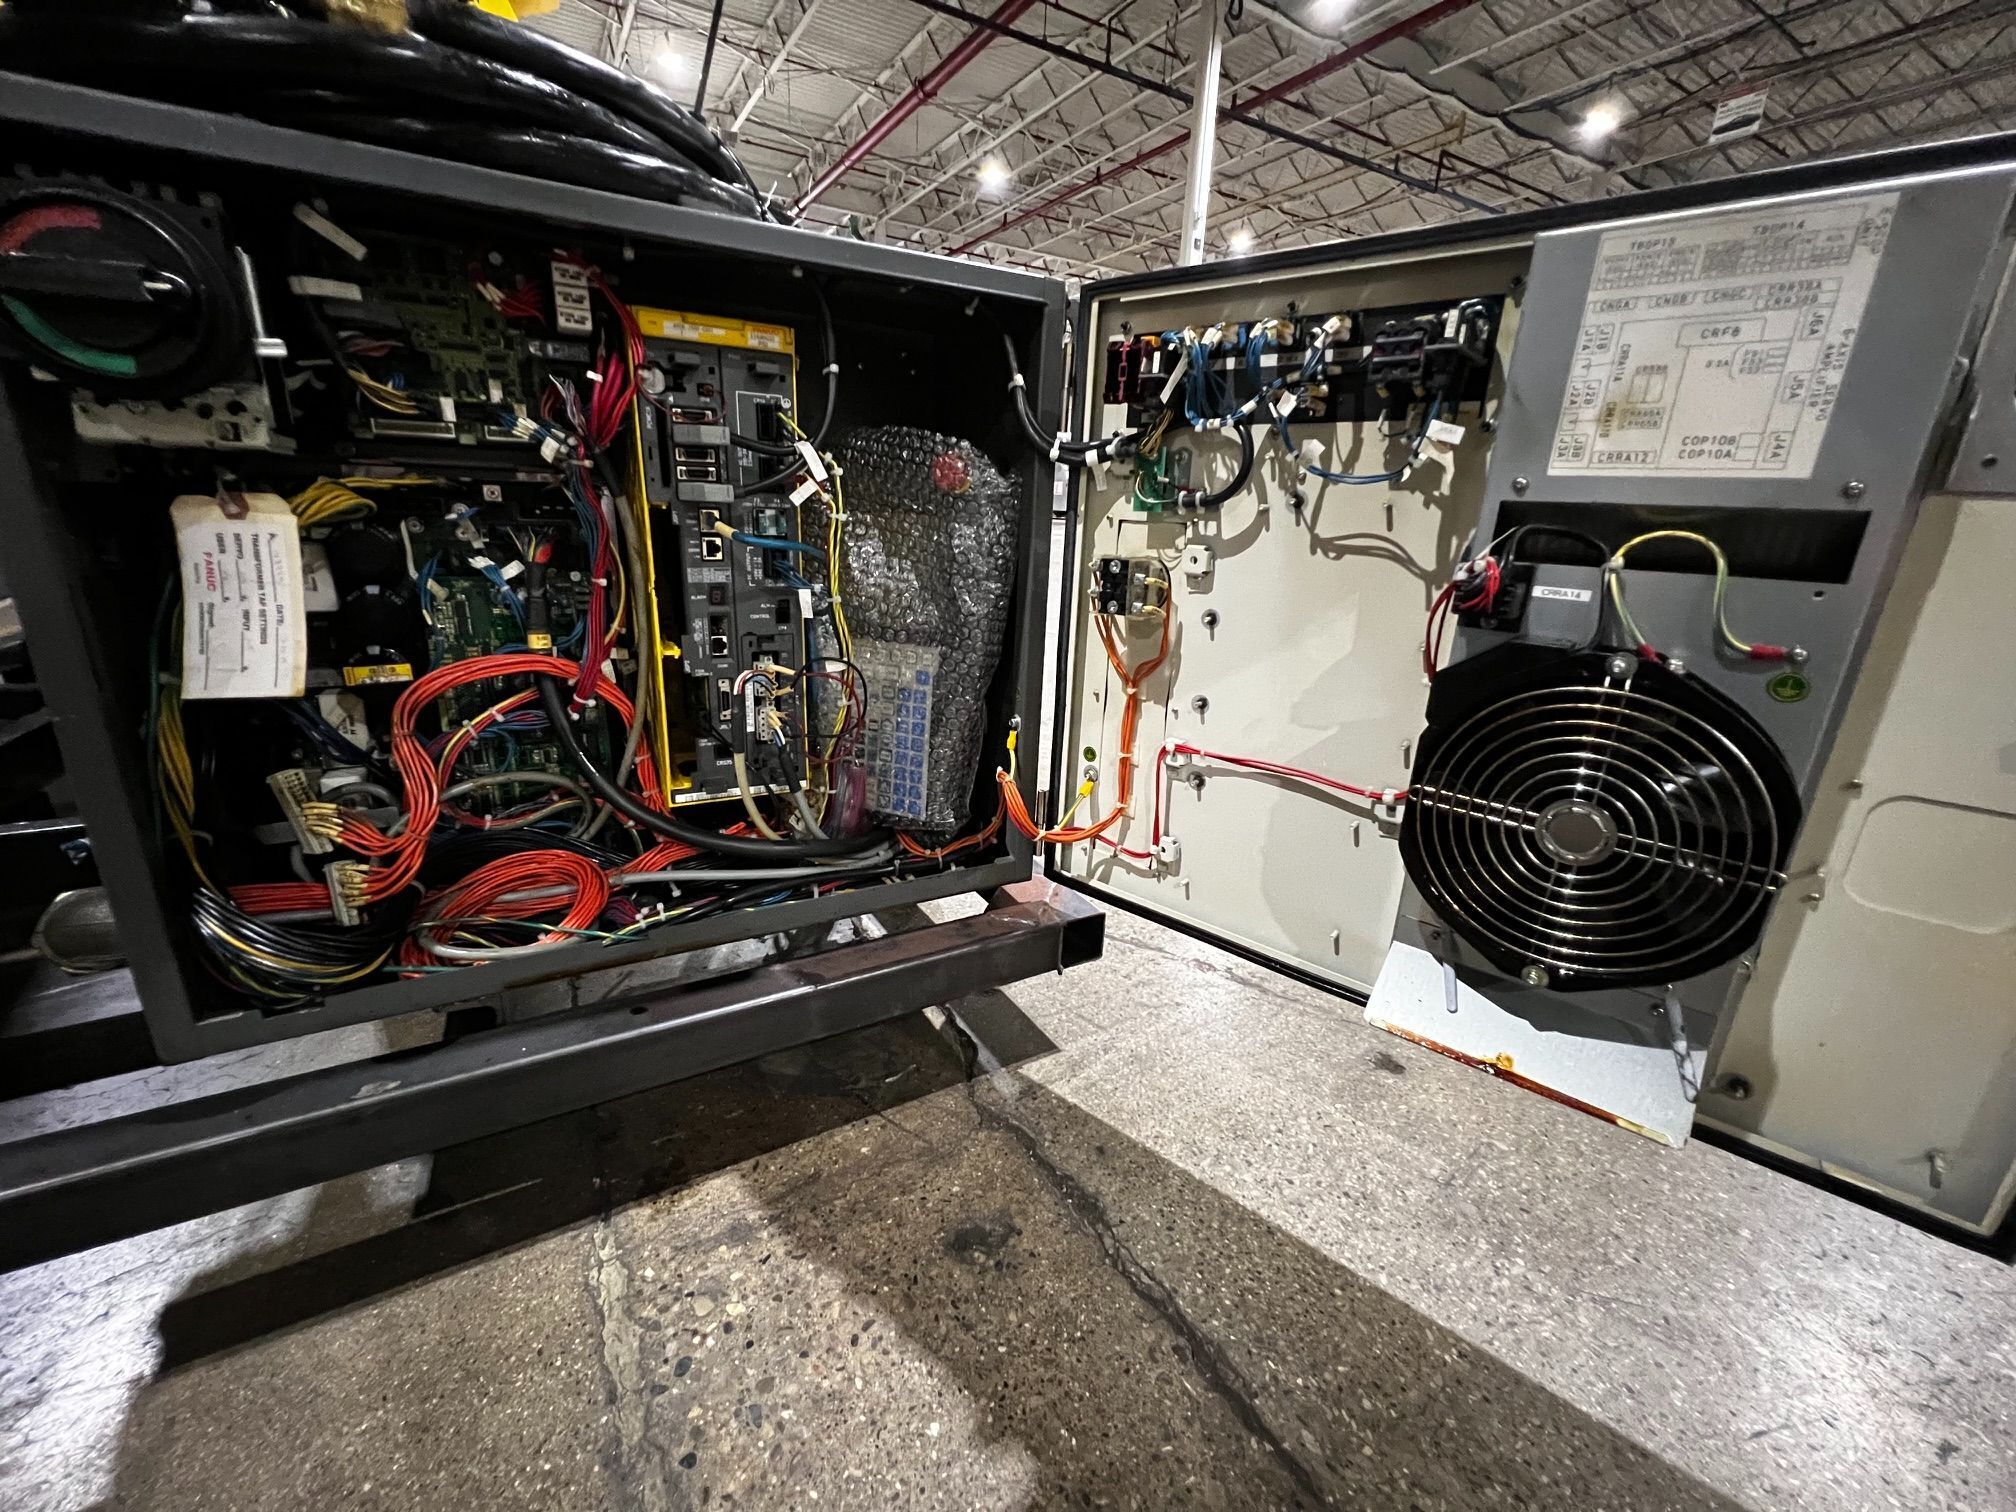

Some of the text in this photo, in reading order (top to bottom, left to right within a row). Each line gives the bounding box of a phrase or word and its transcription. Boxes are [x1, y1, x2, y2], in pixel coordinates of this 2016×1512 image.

[1681, 435, 1738, 447] COP10B
[1598, 452, 1650, 463] CRRA12
[1678, 448, 1734, 460] COP10A
[203, 551, 217, 592] FANUC
